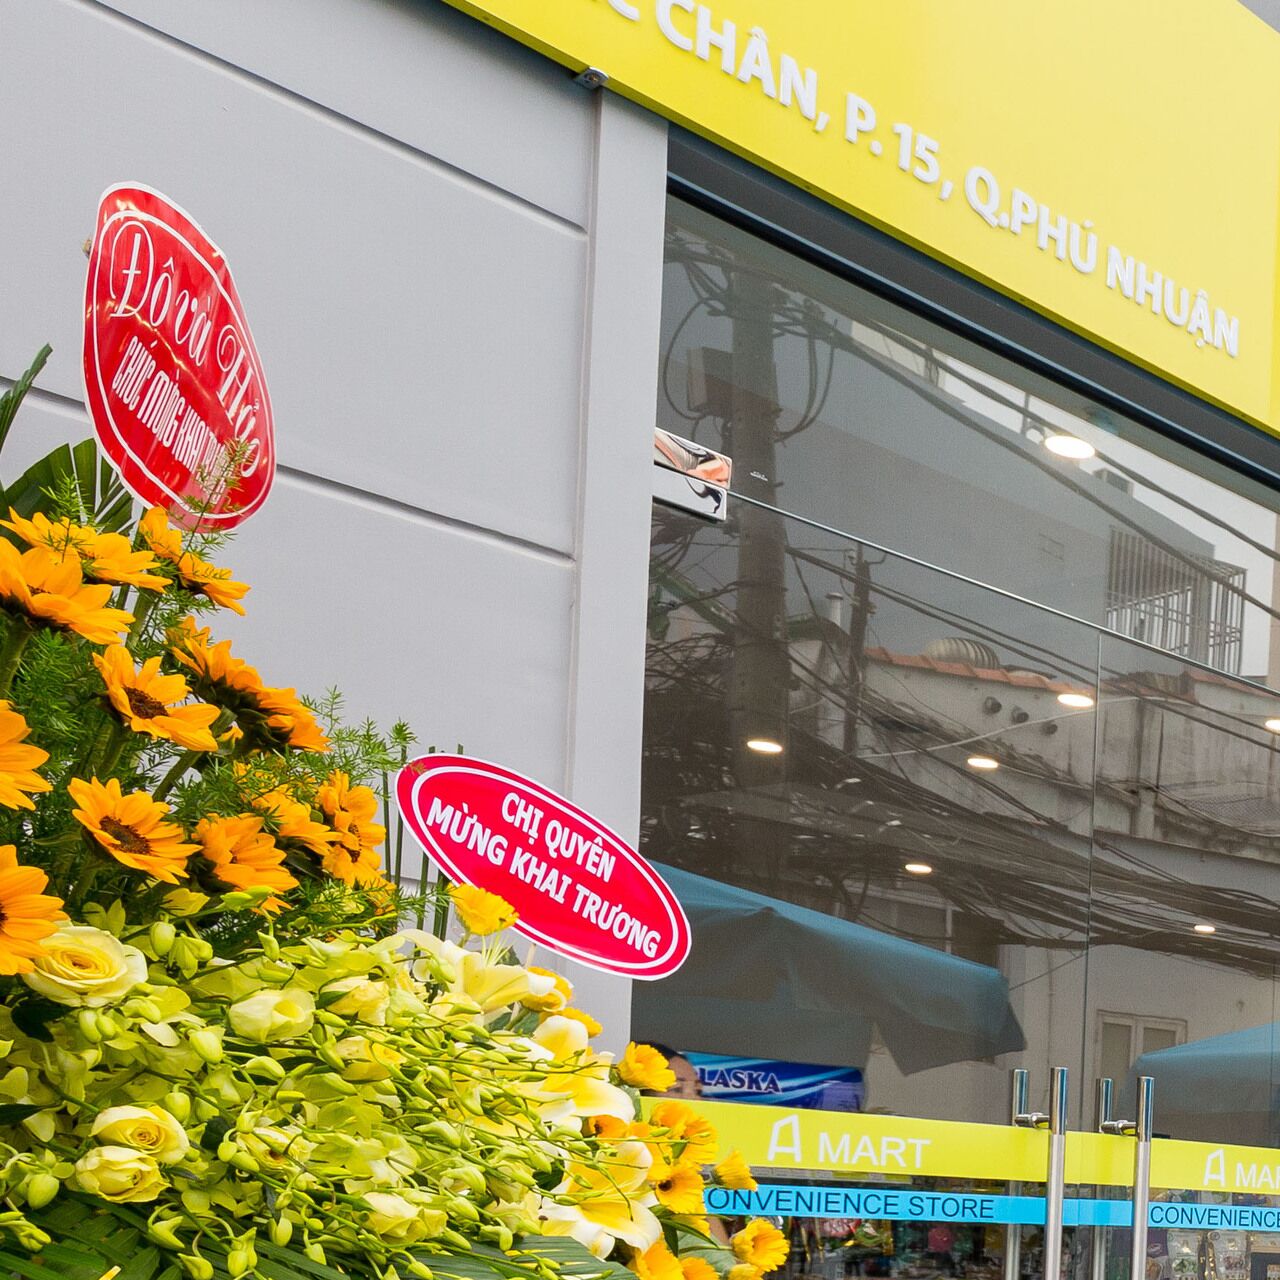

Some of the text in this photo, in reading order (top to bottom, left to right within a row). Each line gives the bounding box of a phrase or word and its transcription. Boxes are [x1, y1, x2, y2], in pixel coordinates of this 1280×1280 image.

[655, 0, 1240, 358] CHÂN, P. 15, Q.PHÚ NHUẬN
[112, 335, 157, 412] CHÚC
[502, 792, 617, 883] CHỊ QUYÊN
[426, 796, 662, 959] MỪNG KHAI TRƯƠNG
[698, 1067, 783, 1093] LASKA
[767, 1114, 932, 1169] A MART
[1203, 1149, 1226, 1187] A
[707, 1187, 995, 1219] ONVENIENCE STORE
